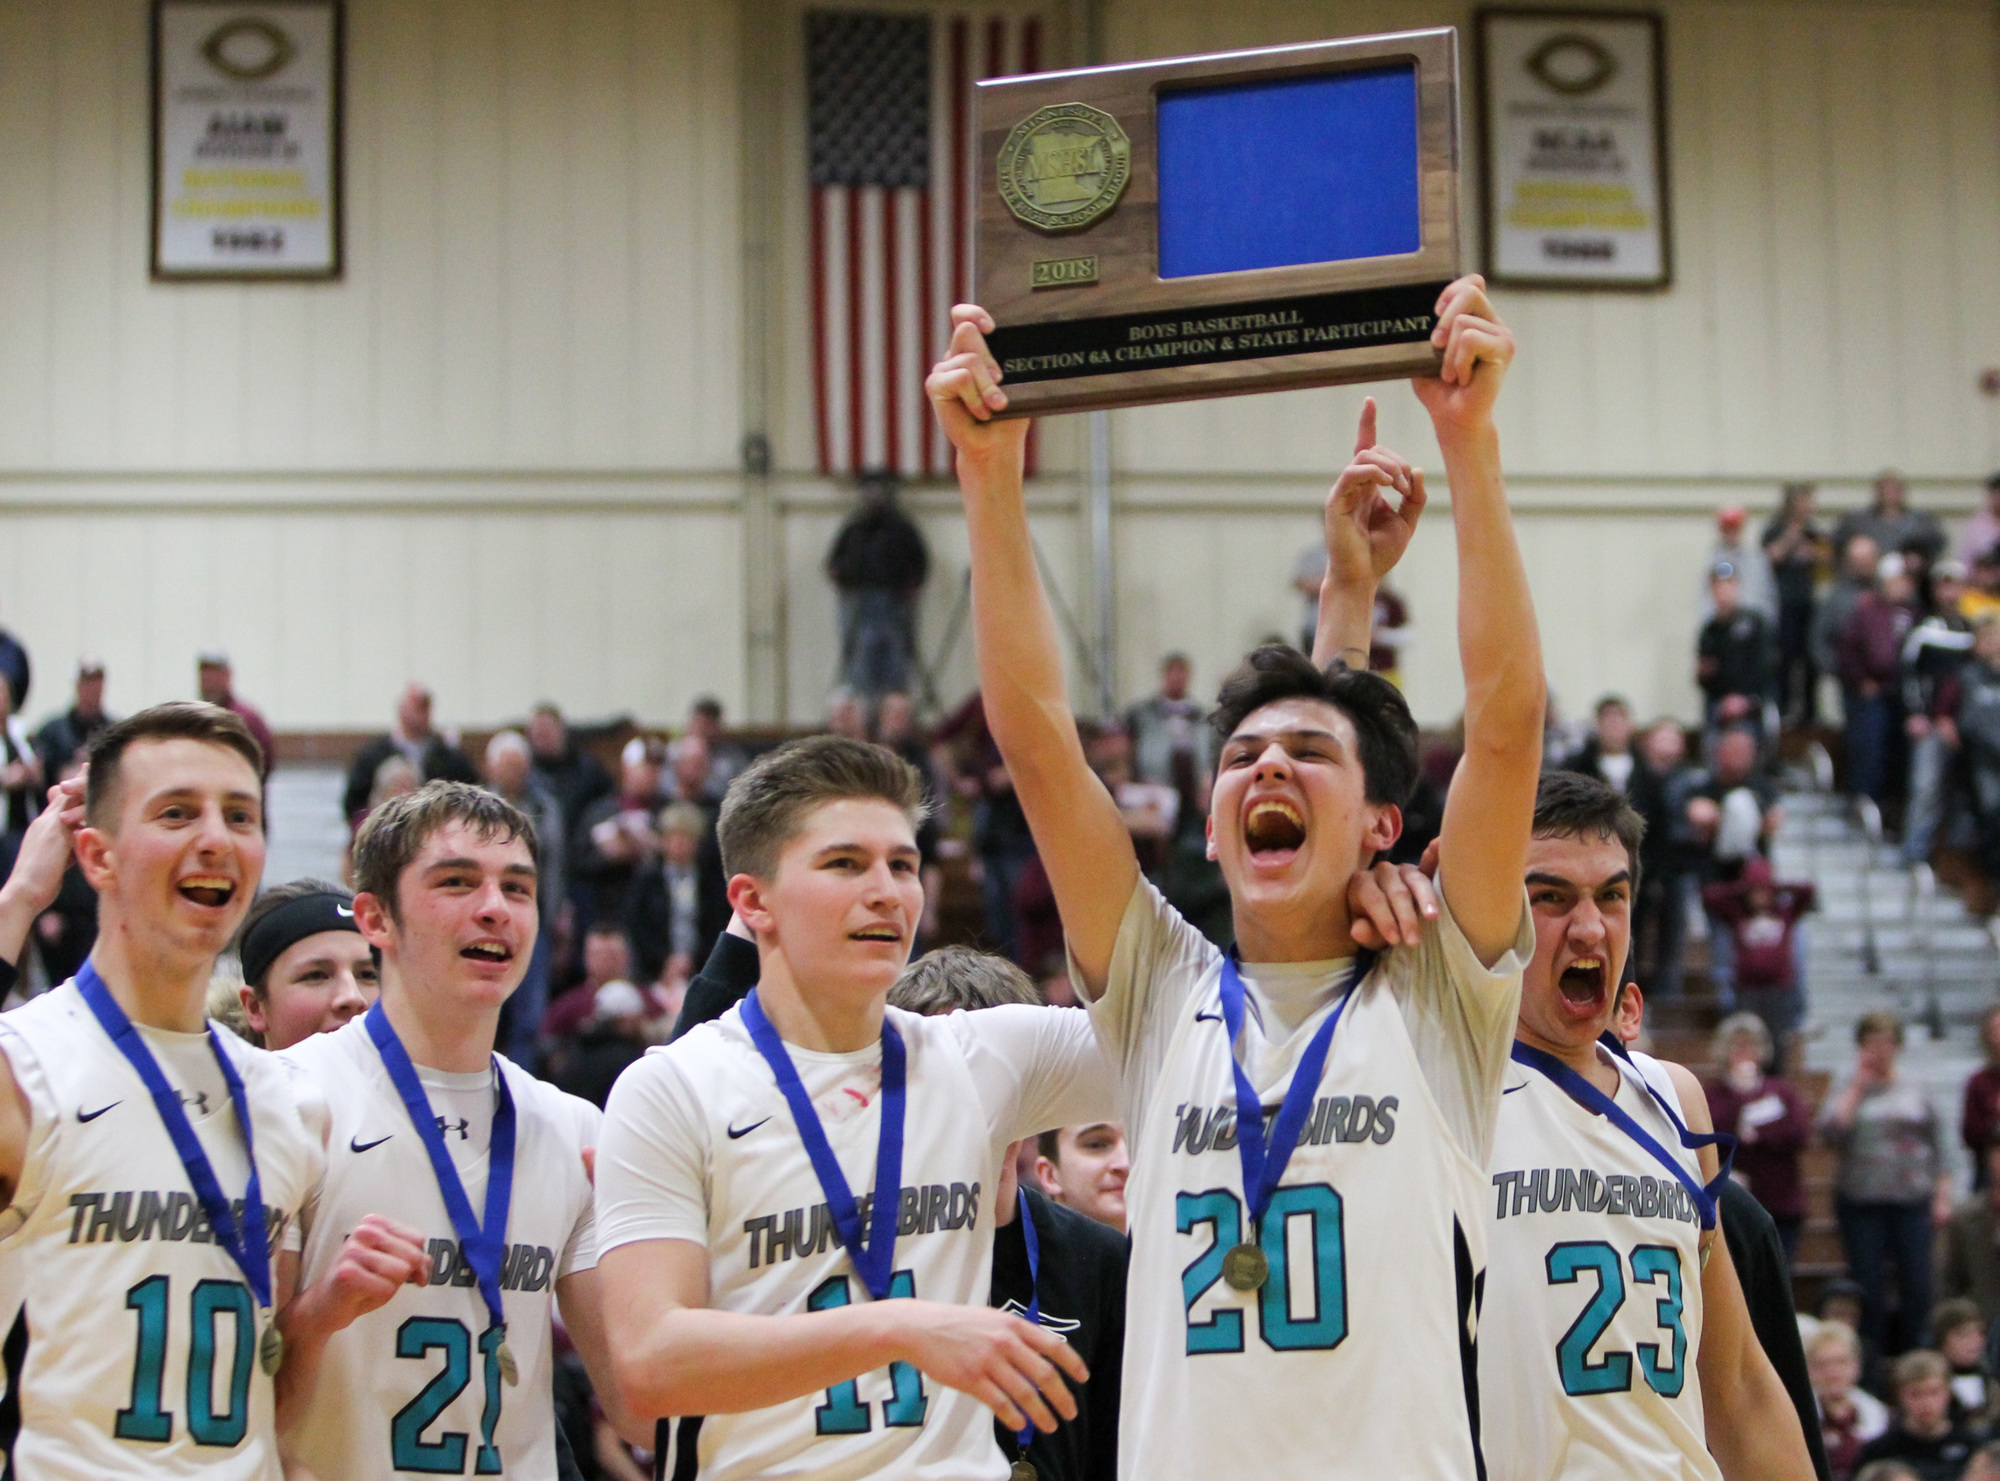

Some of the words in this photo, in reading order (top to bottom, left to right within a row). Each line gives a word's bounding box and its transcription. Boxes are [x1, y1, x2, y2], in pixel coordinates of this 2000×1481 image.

[1003, 351, 1086, 373] SECTION
[1088, 347, 1112, 364] 6A
[1115, 338, 1217, 362] CHAMPION
[1220, 335, 1236, 351] &
[1238, 329, 1299, 349] STATE
[1302, 315, 1432, 343] PARTICIPANT
[1035, 259, 1093, 283] 2018
[1128, 322, 1178, 342] BOYS
[1182, 309, 1304, 335] BASKETBALL
[1175, 1181, 1350, 1357] 20
[1544, 1240, 1688, 1399] 23
[114, 1274, 256, 1447] 10
[390, 1315, 506, 1476] 21
